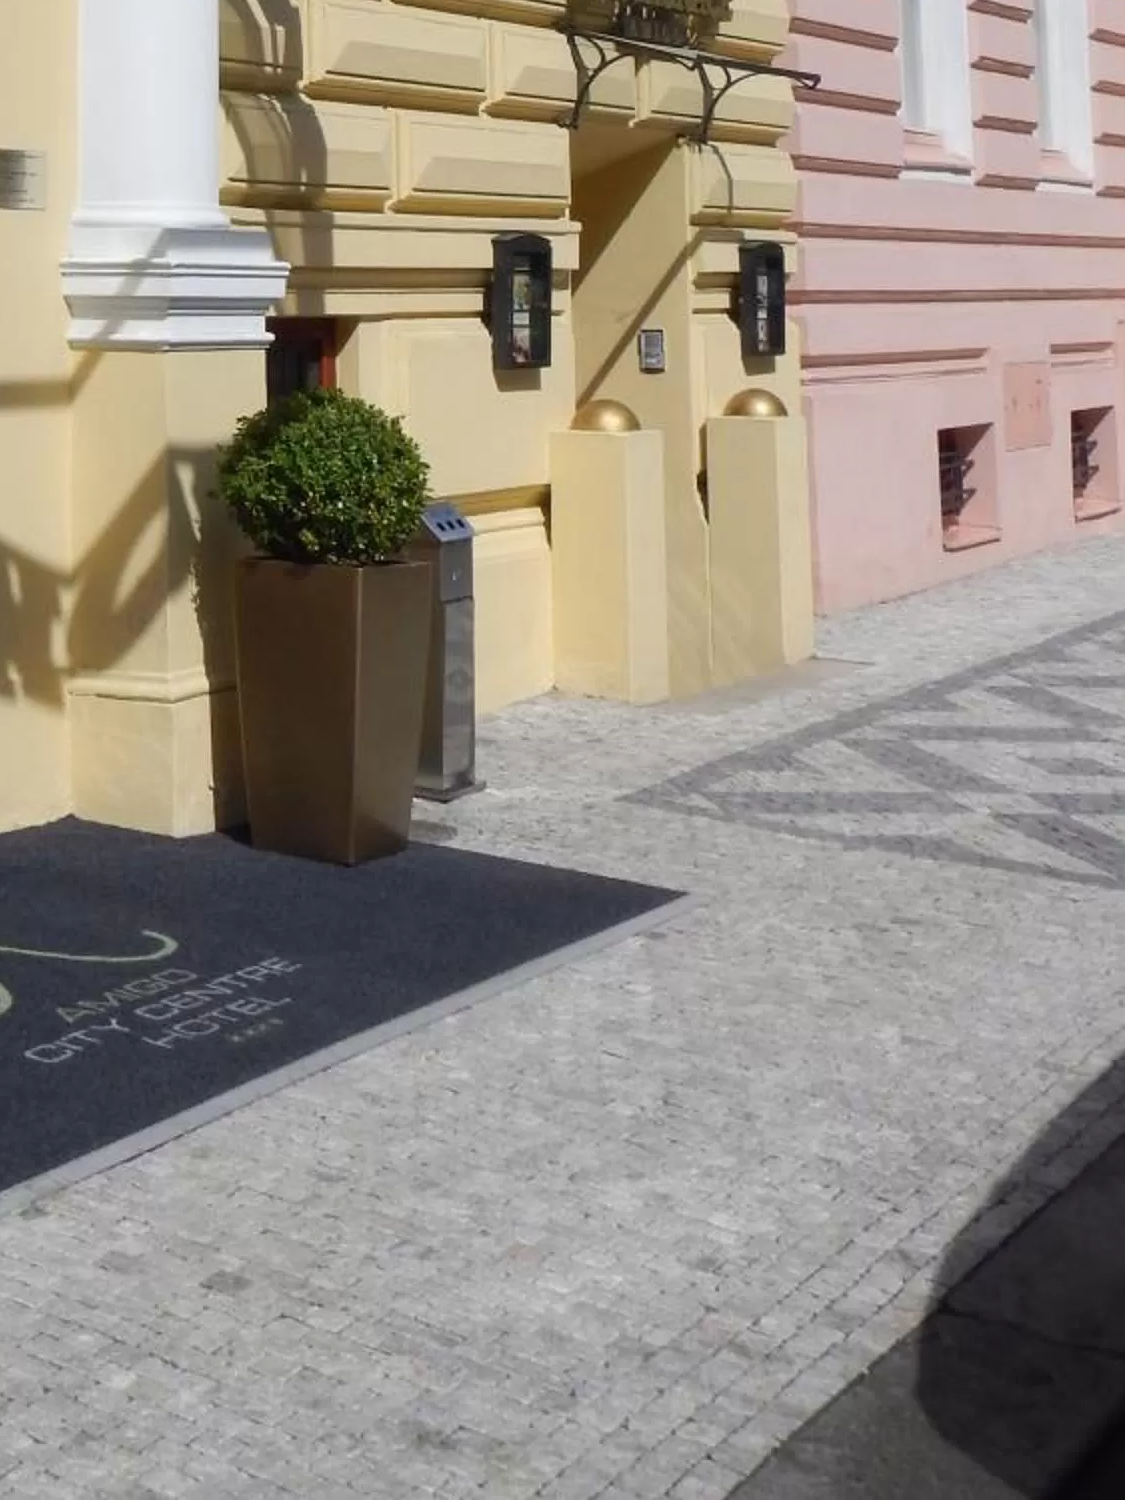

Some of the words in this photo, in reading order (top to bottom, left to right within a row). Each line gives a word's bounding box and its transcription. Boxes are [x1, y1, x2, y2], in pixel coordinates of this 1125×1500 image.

[24, 1017, 131, 1063] CITY
[134, 957, 303, 1020] CENTRE
[56, 968, 198, 1024] AMIGO
[142, 996, 292, 1048] HOTEL
